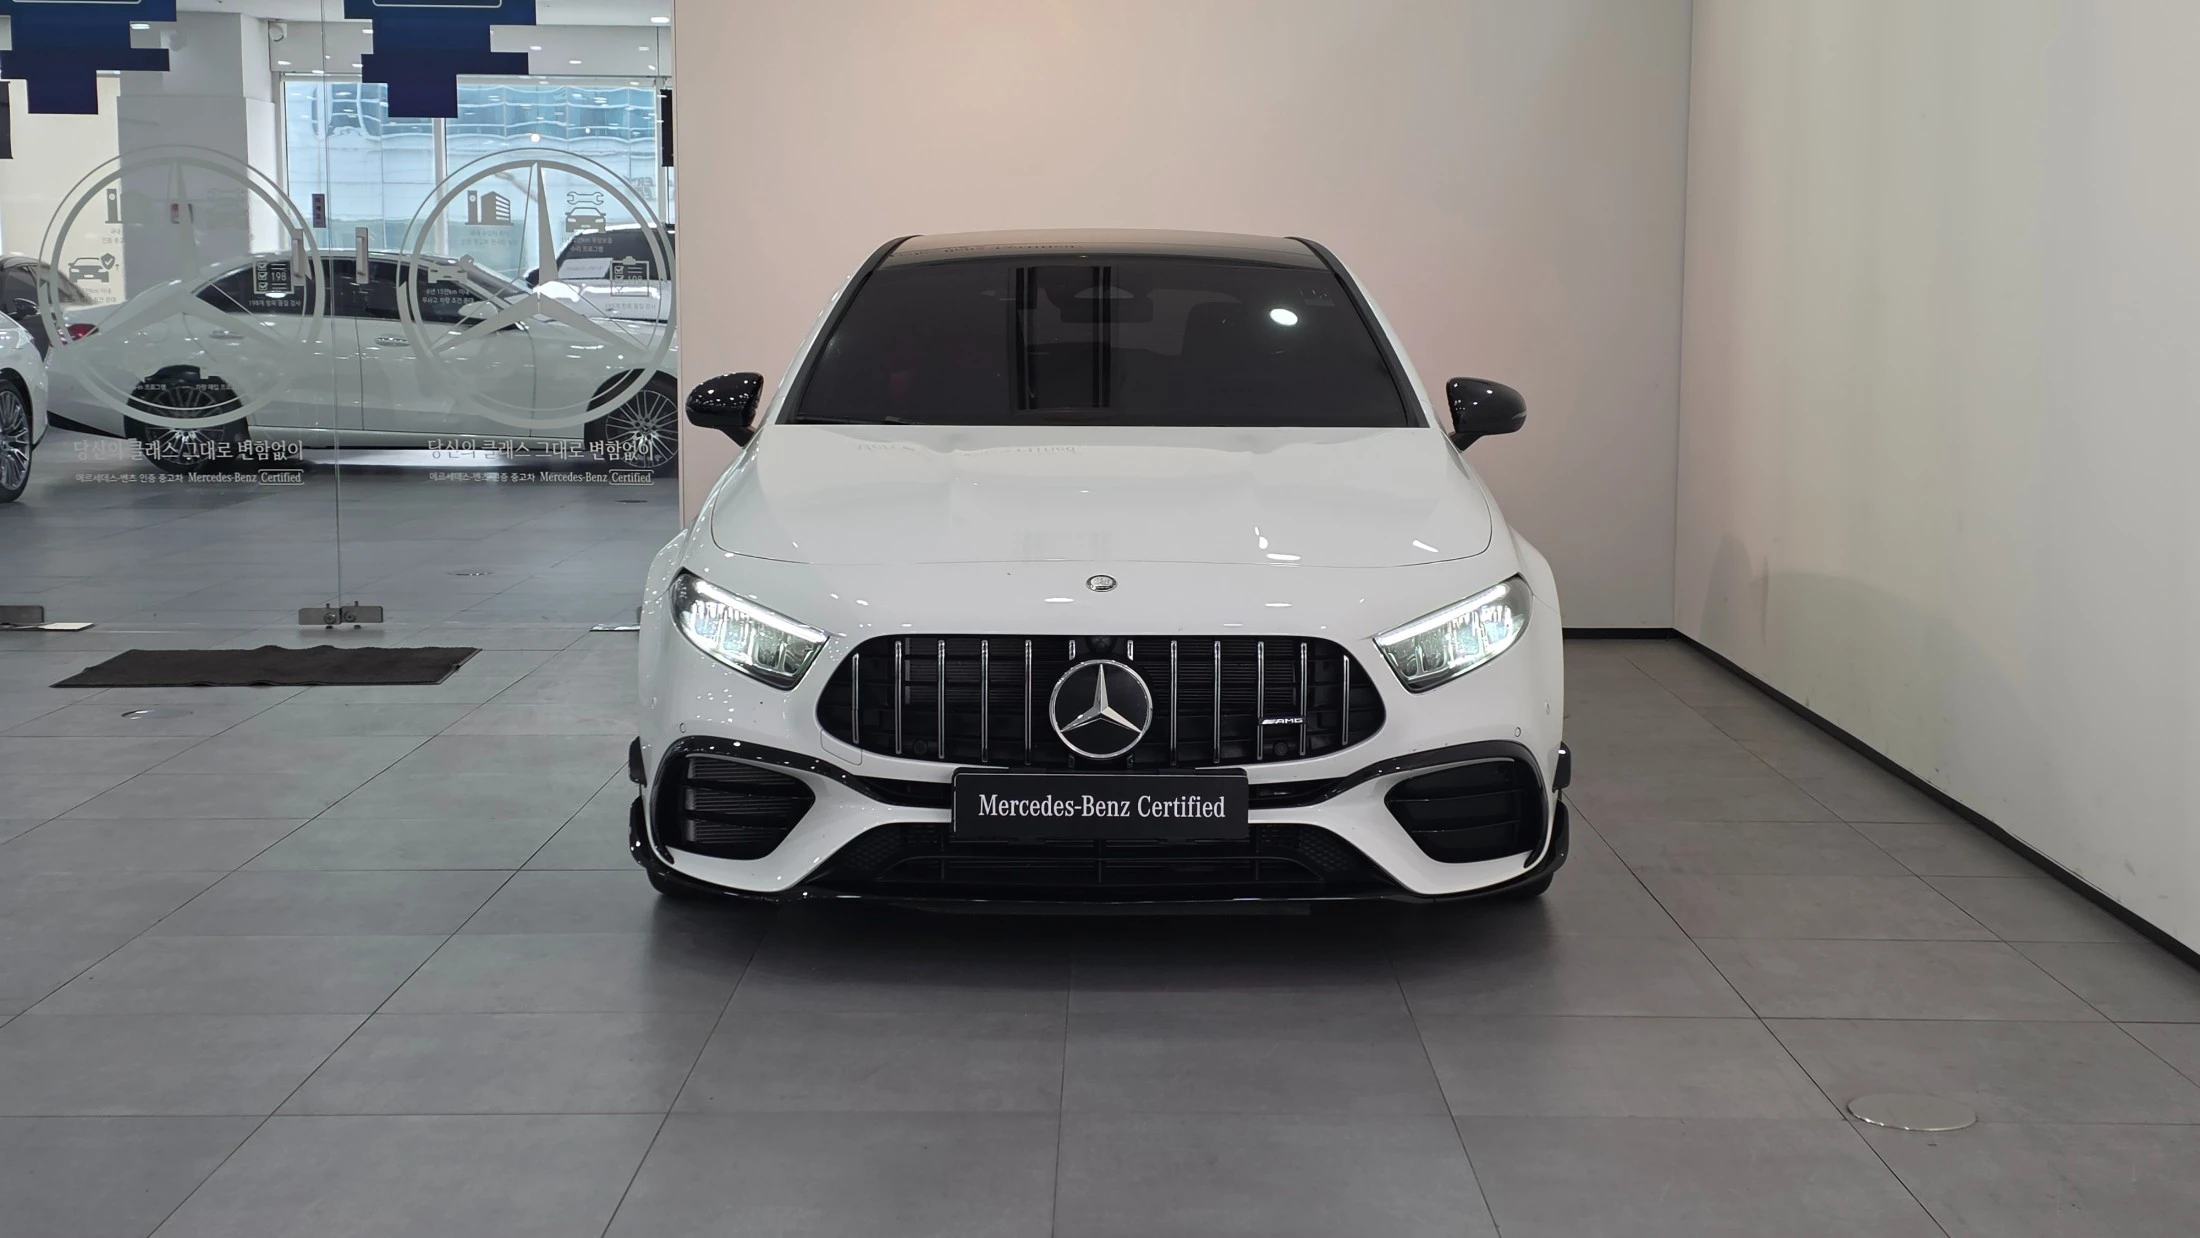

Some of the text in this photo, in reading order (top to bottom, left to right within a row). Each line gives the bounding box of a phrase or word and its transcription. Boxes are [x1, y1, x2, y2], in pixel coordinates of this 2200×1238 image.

[271, 272, 287, 281] 198
[73, 439, 303, 461] 당신의 클래스 그대로 변함없이
[427, 439, 653, 461] 당신의 클래스 그대로 변함없이
[75, 472, 301, 484] 메르세데스-벤츠 인증 중고차 Mercedes-Benz Certified
[429, 472, 488, 482] 메르세데스-벤츠
[511, 472, 536, 483] 중고차
[540, 471, 608, 482] Mercedes-Benz
[611, 472, 651, 483] Certified
[1275, 717, 1303, 725] AMG
[978, 794, 1226, 818] Mercedes-Benz Certified
